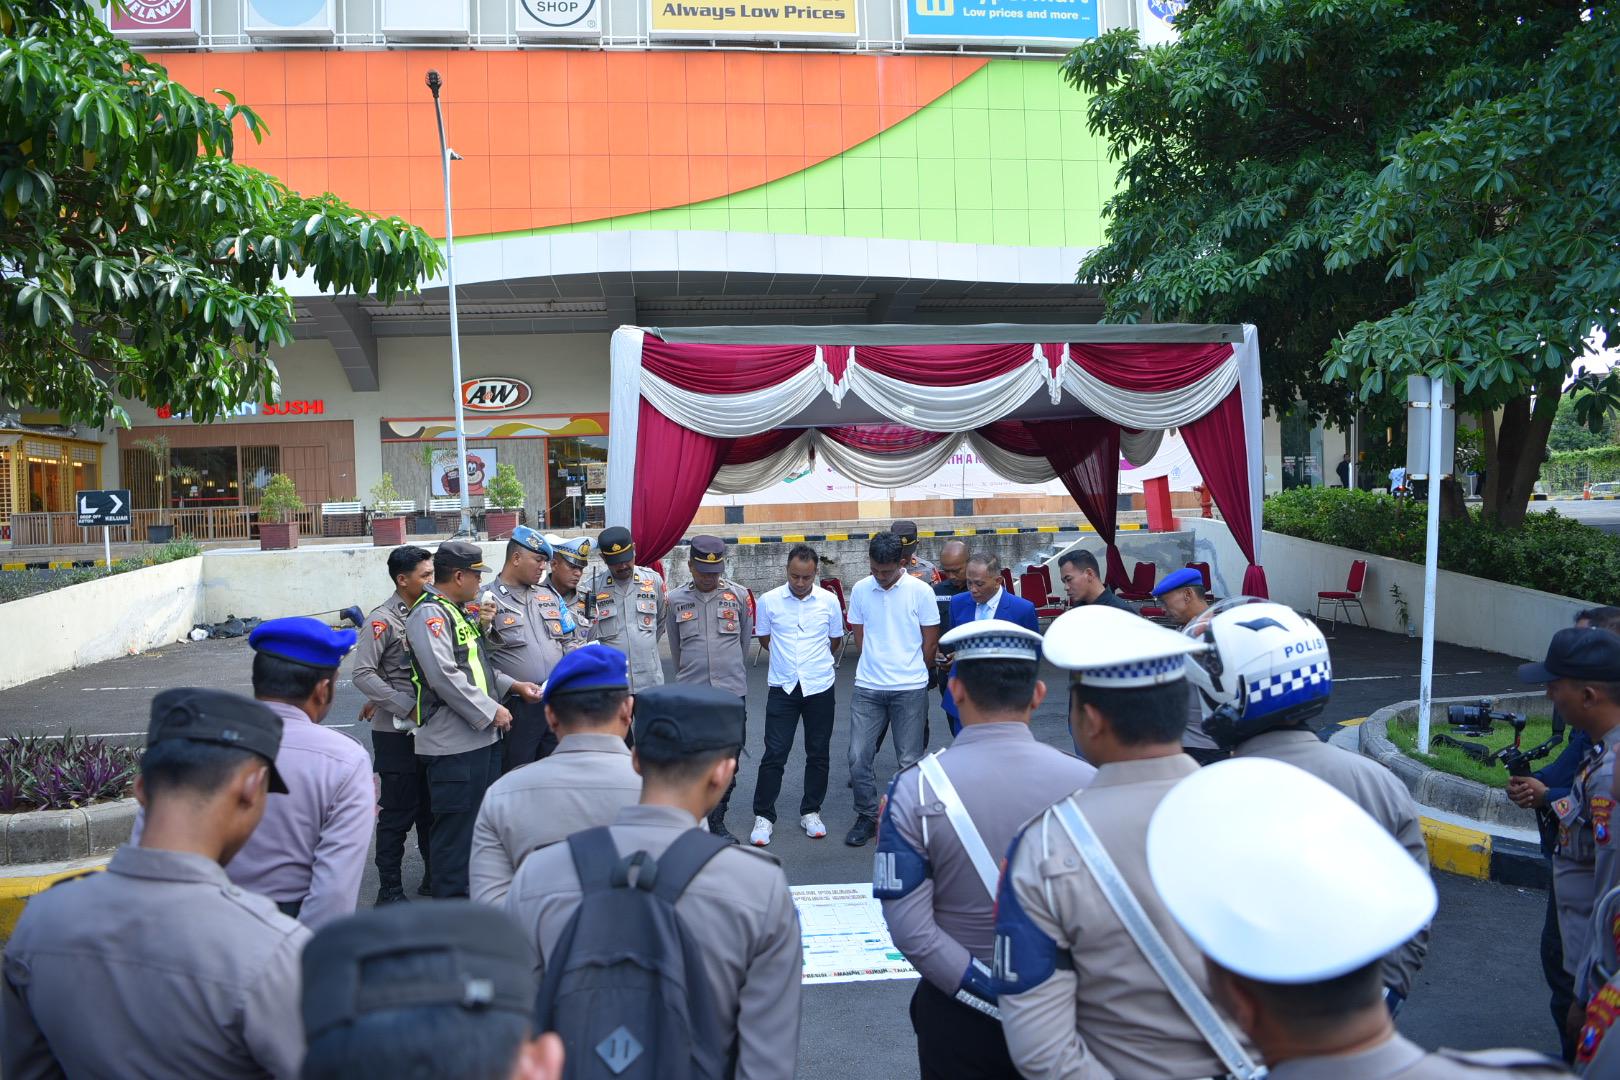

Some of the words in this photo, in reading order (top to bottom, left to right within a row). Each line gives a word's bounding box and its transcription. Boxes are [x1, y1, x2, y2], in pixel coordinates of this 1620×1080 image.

[537, 2, 578, 12] SHOP
[662, 3, 736, 20] Always
[741, 4, 779, 18] Low
[784, 5, 845, 19] Prices
[963, 7, 986, 16] Low
[989, 7, 1024, 19] prices
[1026, 9, 1048, 19] and
[1050, 12, 1079, 20] more
[467, 384, 518, 404] A&W
[263, 400, 324, 415] SUSHI
